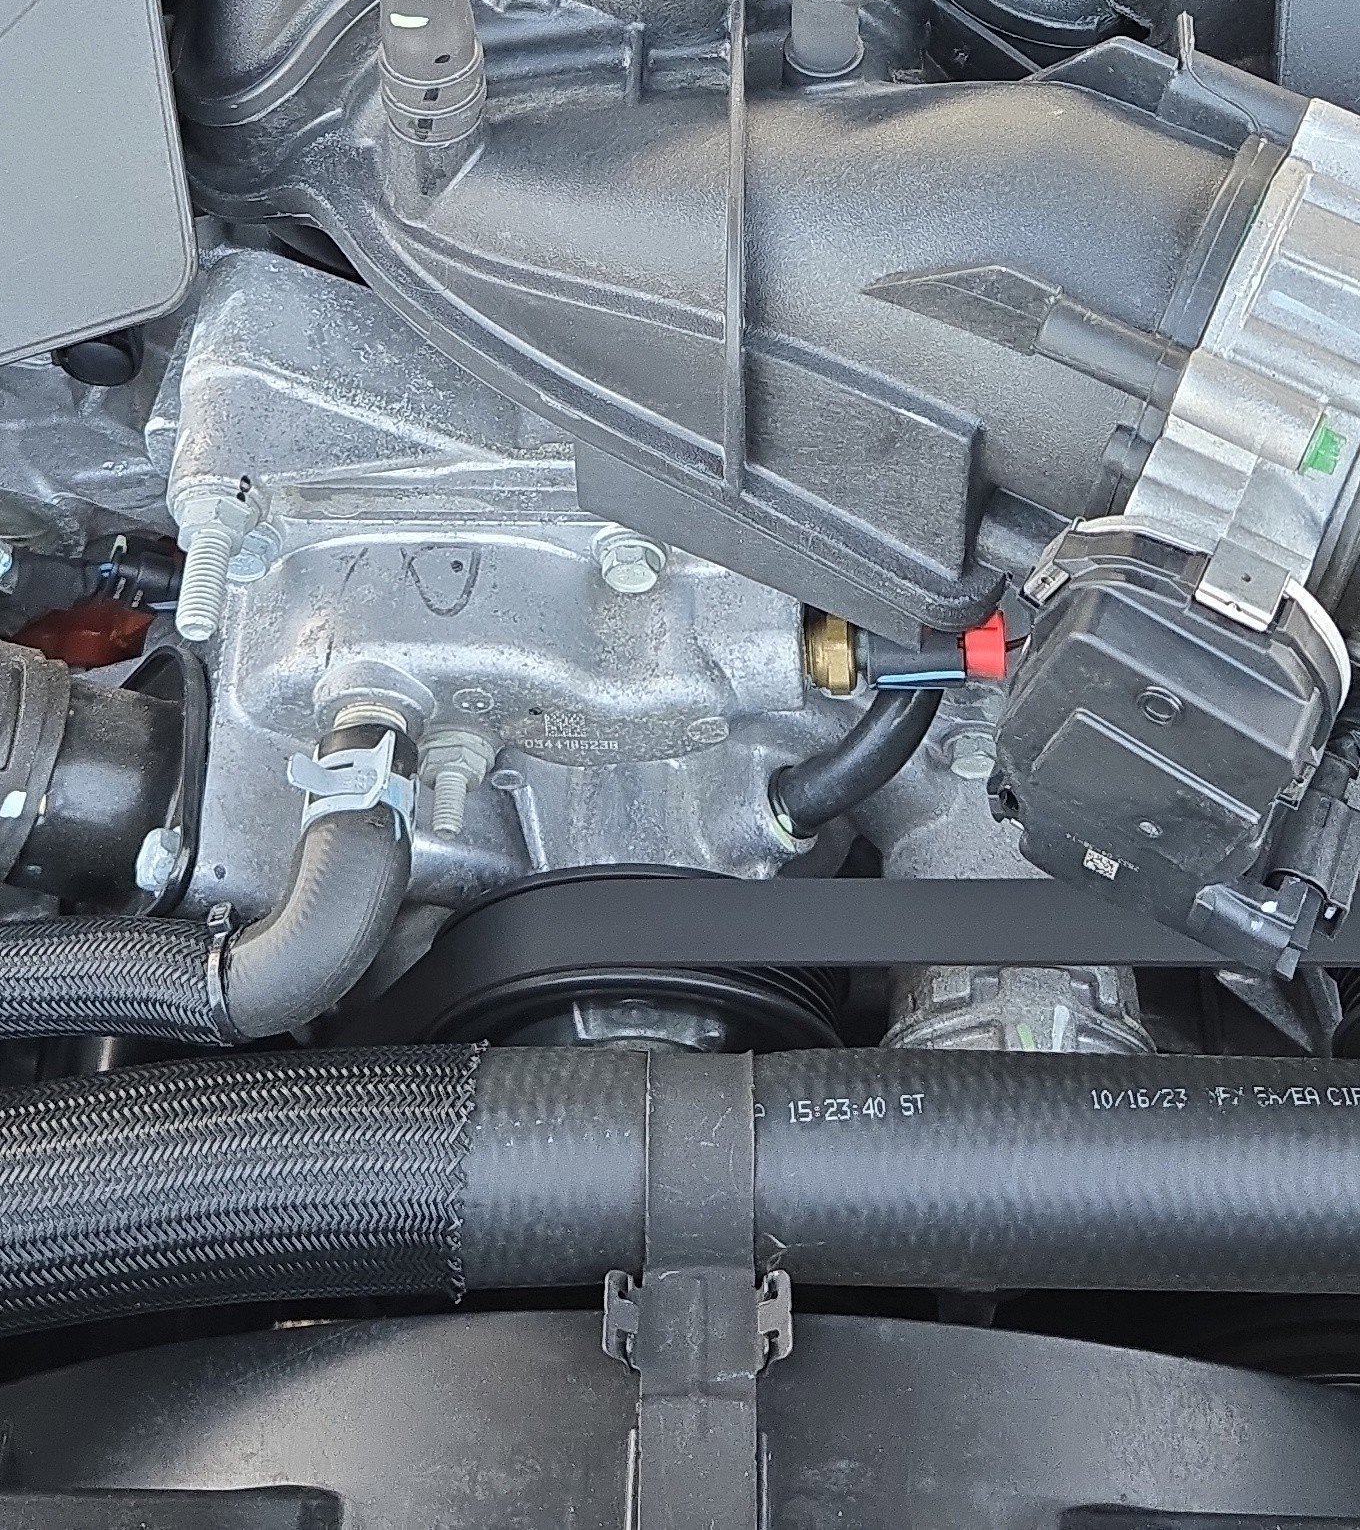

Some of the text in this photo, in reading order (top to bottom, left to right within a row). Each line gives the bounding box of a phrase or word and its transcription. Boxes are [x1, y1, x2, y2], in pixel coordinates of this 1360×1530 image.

[787, 1097, 887, 1123] 15:23:40
[899, 1093, 926, 1117] ST
[1089, 1088, 1189, 1110] 10/16/23
